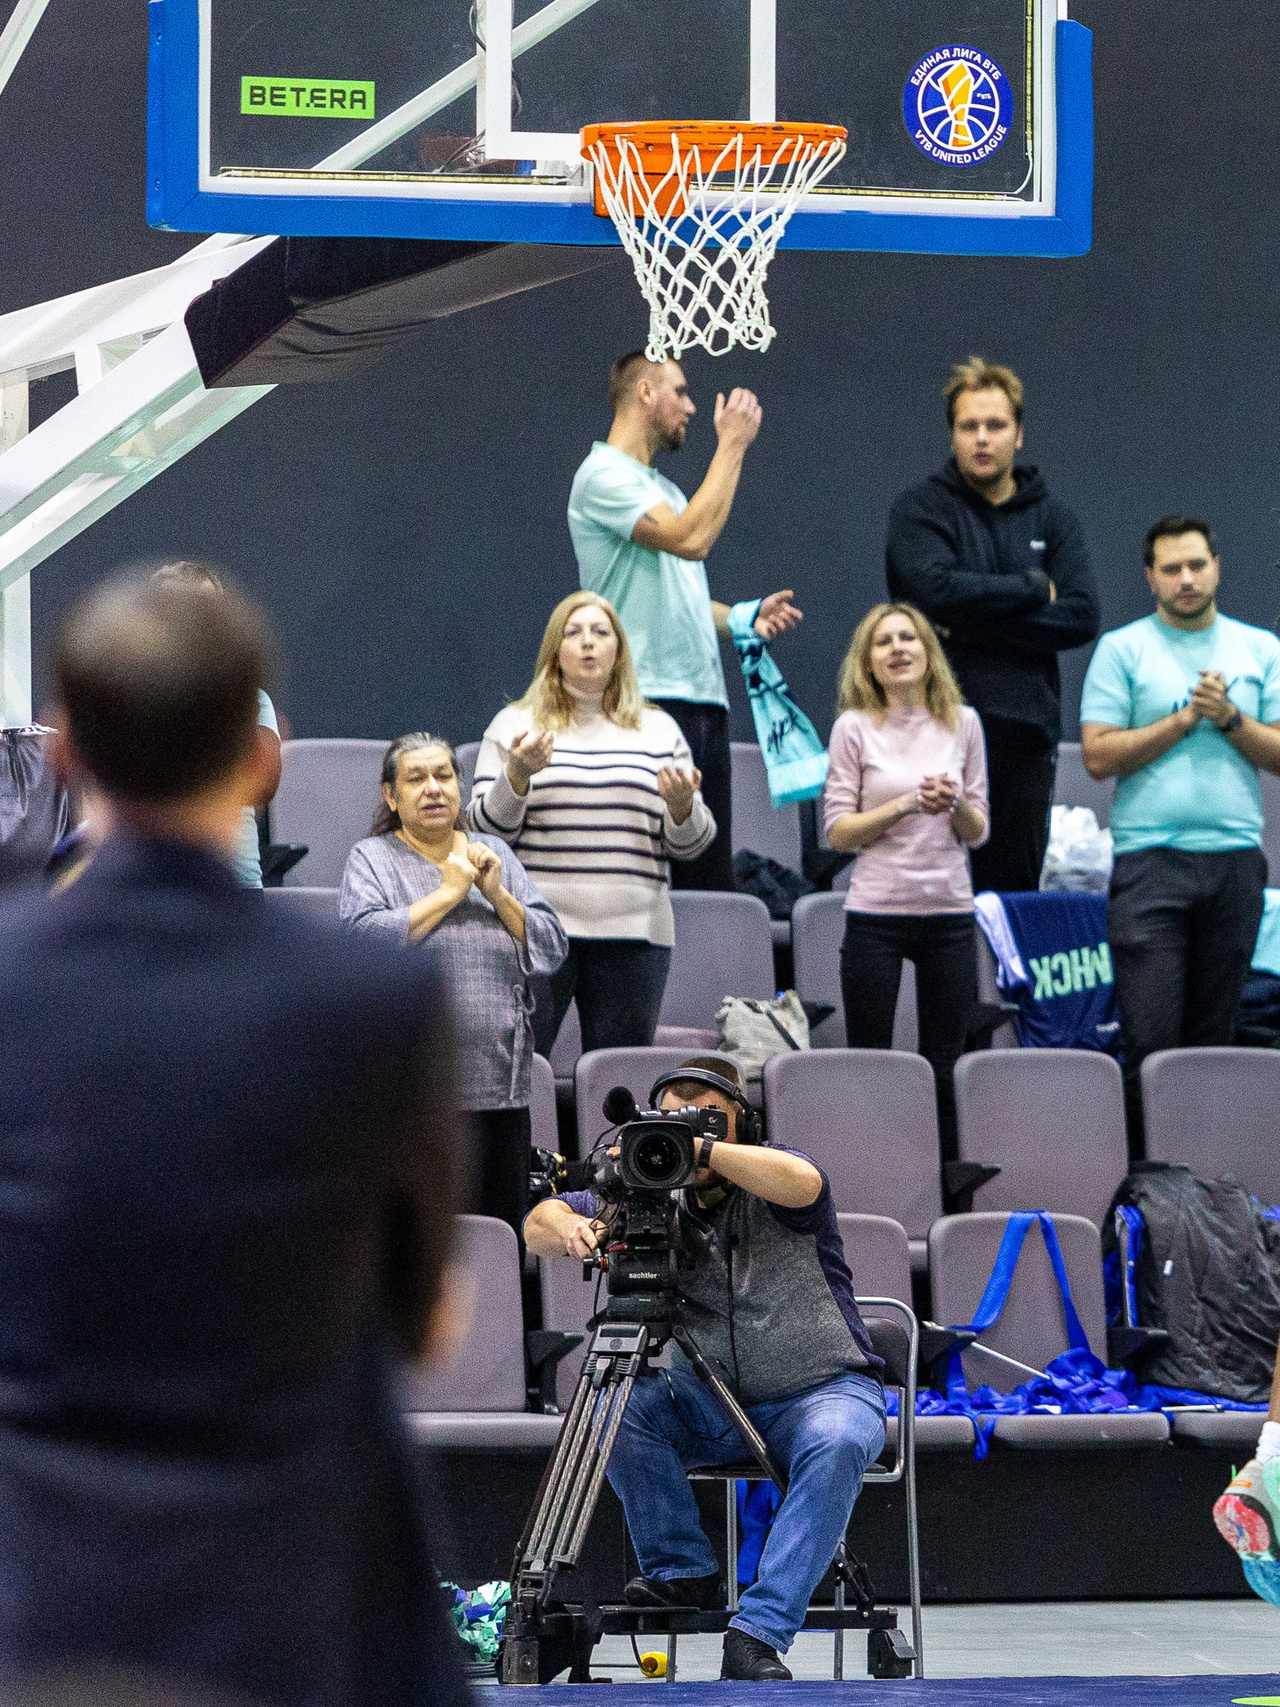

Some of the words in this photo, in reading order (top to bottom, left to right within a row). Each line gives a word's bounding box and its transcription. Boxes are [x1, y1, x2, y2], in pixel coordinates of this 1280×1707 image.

[910, 48, 951, 87] ЕДИНАЯ
[952, 47, 982, 64] ЛИГА
[981, 59, 1002, 81] ВТБ
[914, 129, 933, 152] VTB
[931, 146, 972, 164] UNITED
[972, 124, 1008, 161] LEAGUE
[628, 1271, 658, 1279] sachtler
